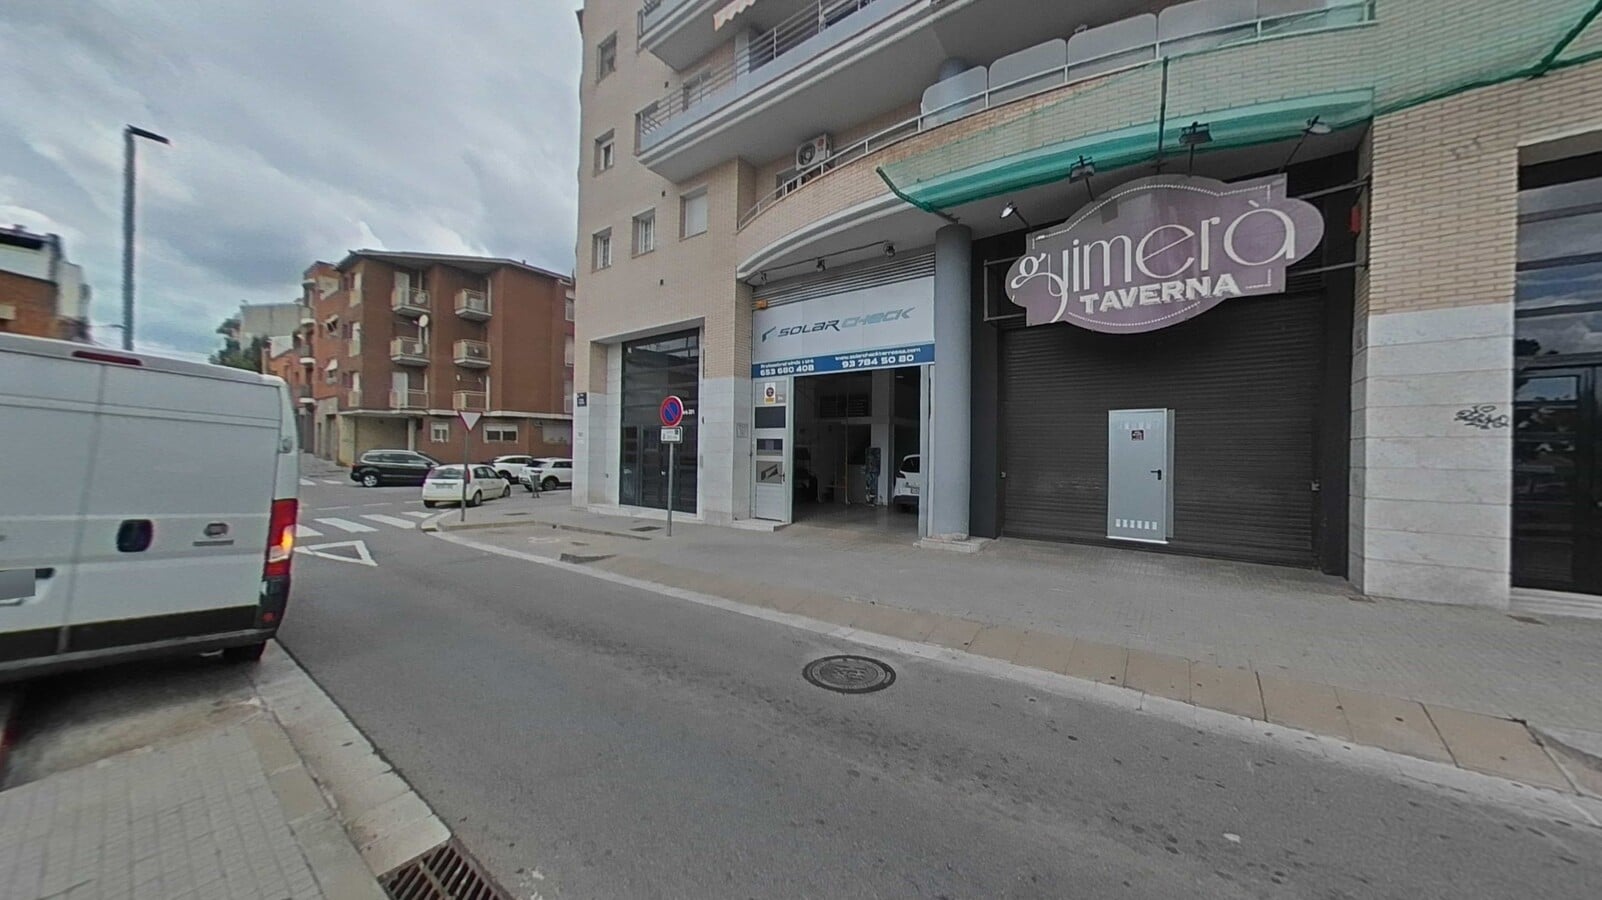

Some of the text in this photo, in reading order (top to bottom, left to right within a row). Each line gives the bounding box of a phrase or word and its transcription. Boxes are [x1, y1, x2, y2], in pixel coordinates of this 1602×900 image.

[1079, 273, 1242, 314] TAVERNA
[841, 354, 914, 369] 93 784 50 80
[760, 368, 776, 377] 653
[777, 366, 794, 374] 680
[796, 364, 814, 372] 408
